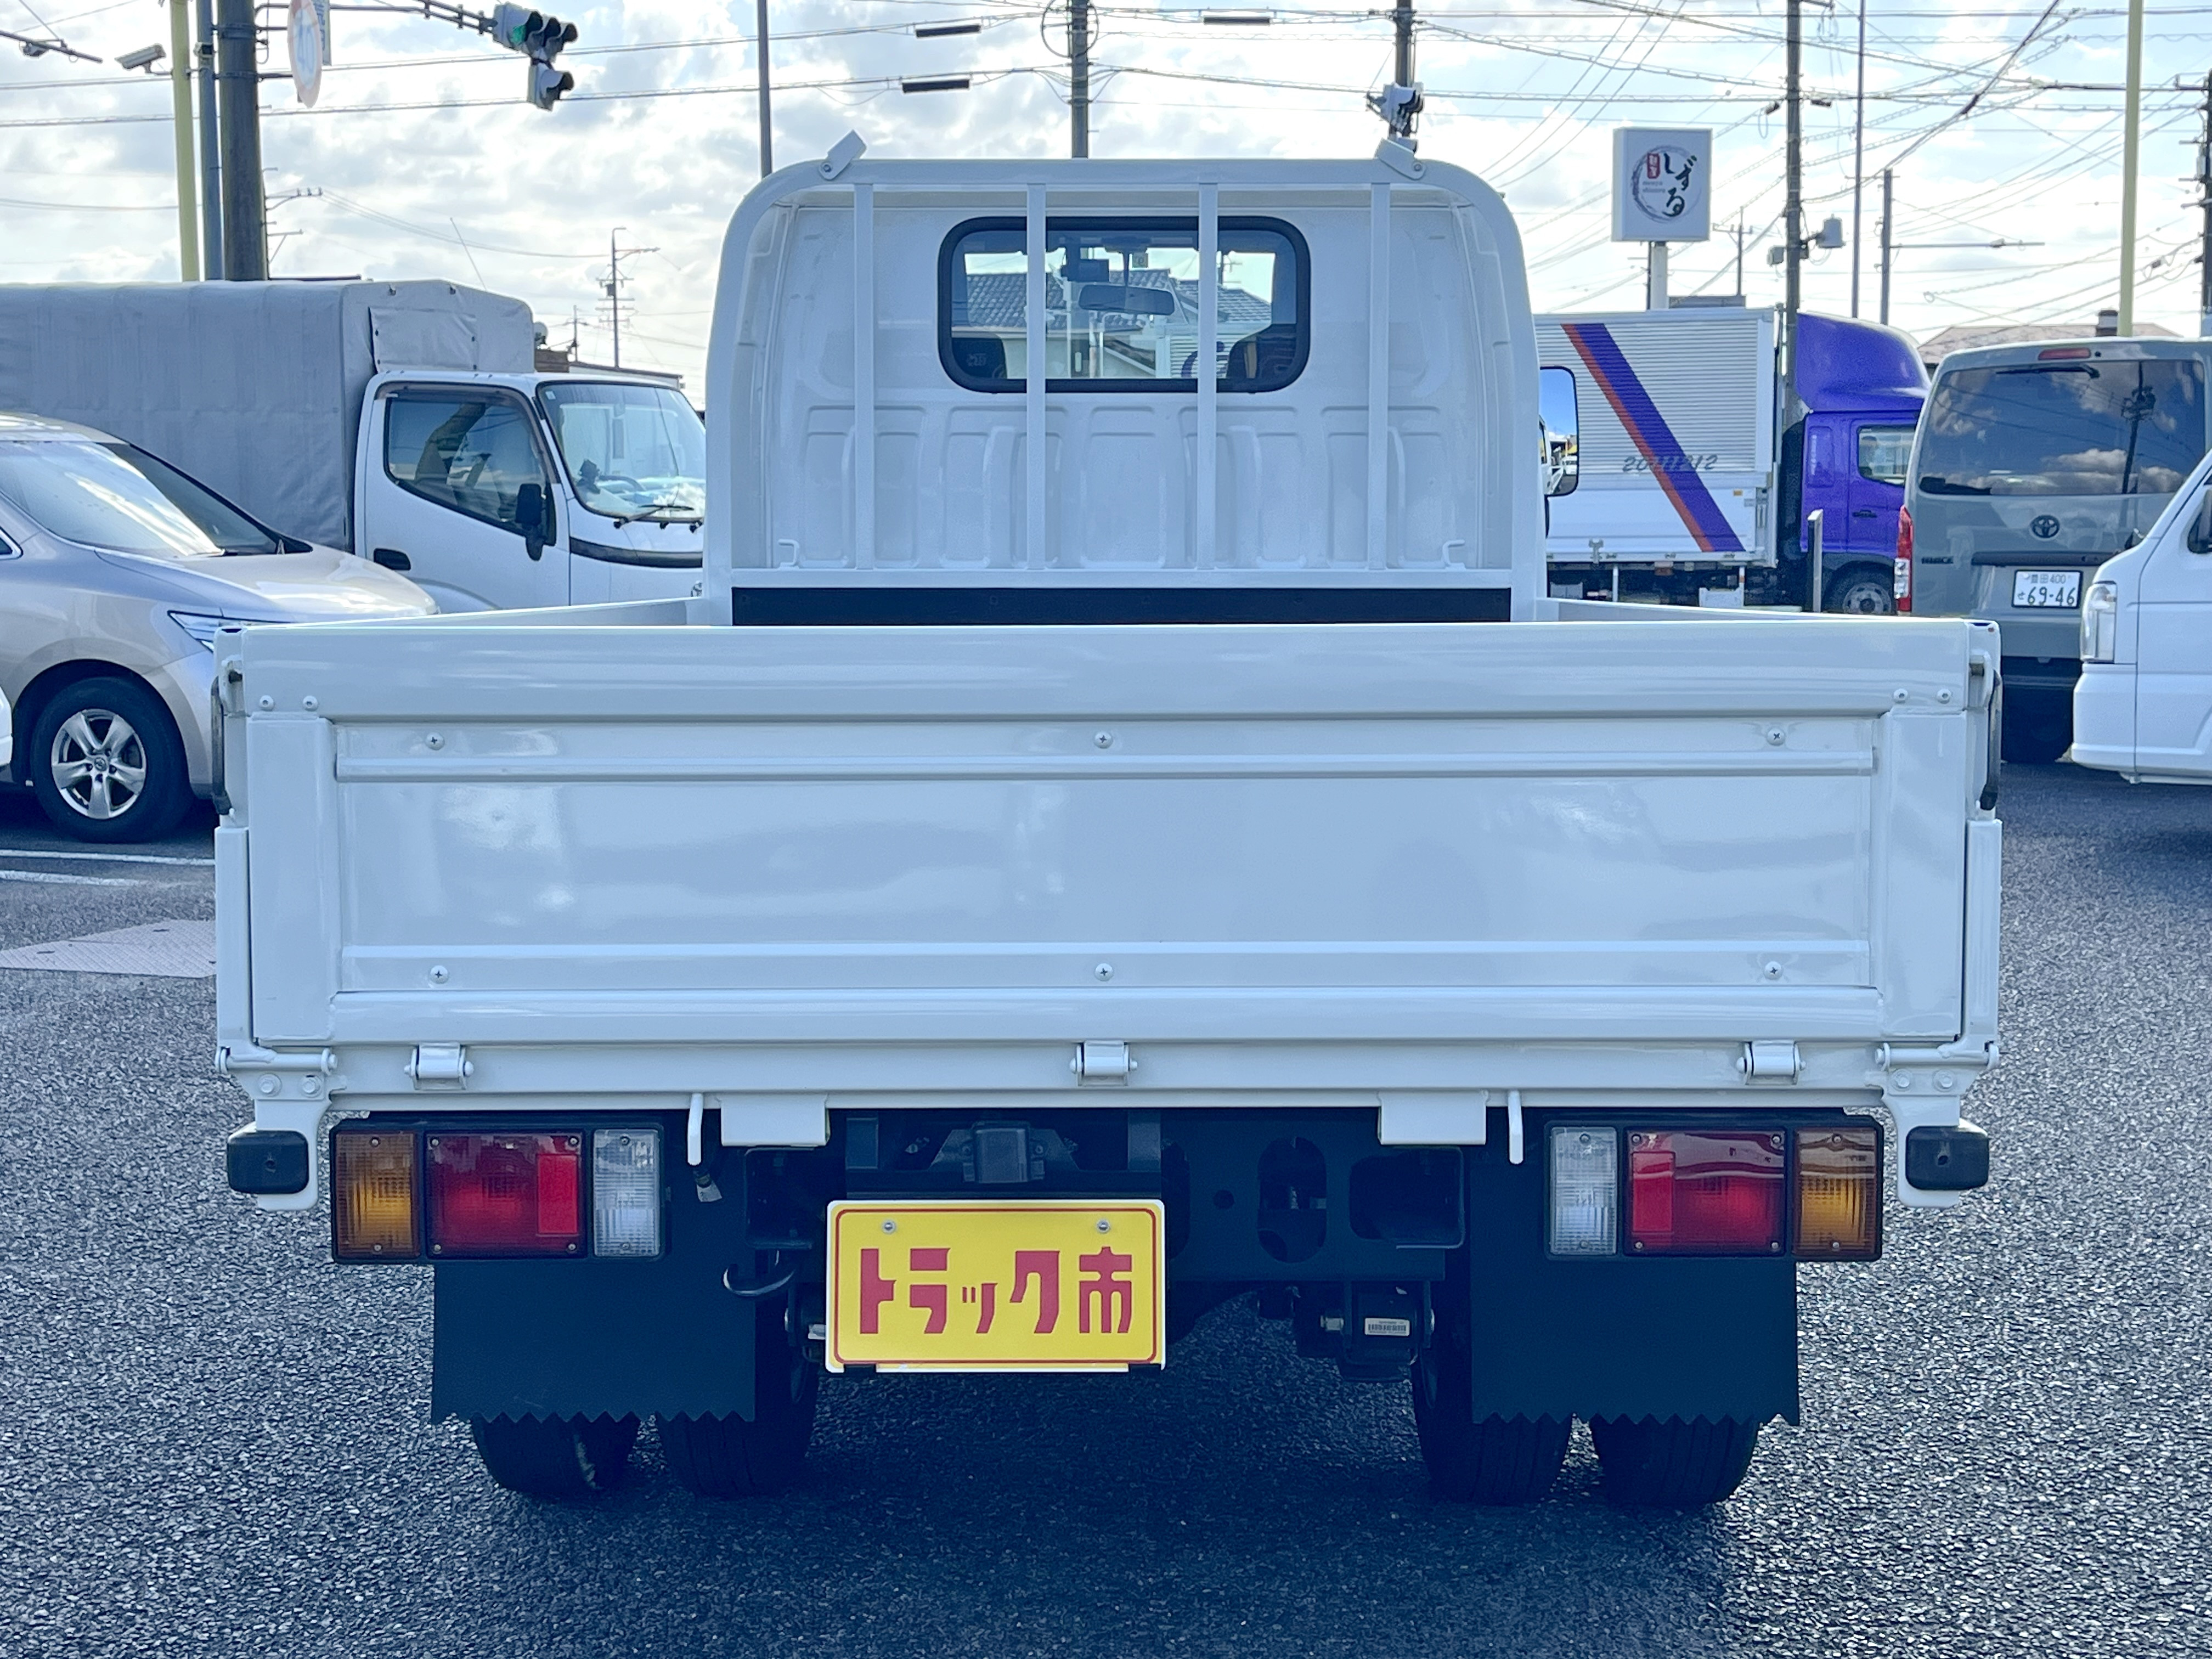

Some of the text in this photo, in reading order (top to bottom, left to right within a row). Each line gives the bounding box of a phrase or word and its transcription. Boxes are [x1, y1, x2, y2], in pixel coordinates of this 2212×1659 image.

[1662, 153, 1697, 217] しずる
[860, 1246, 1132, 1334] トラック市
